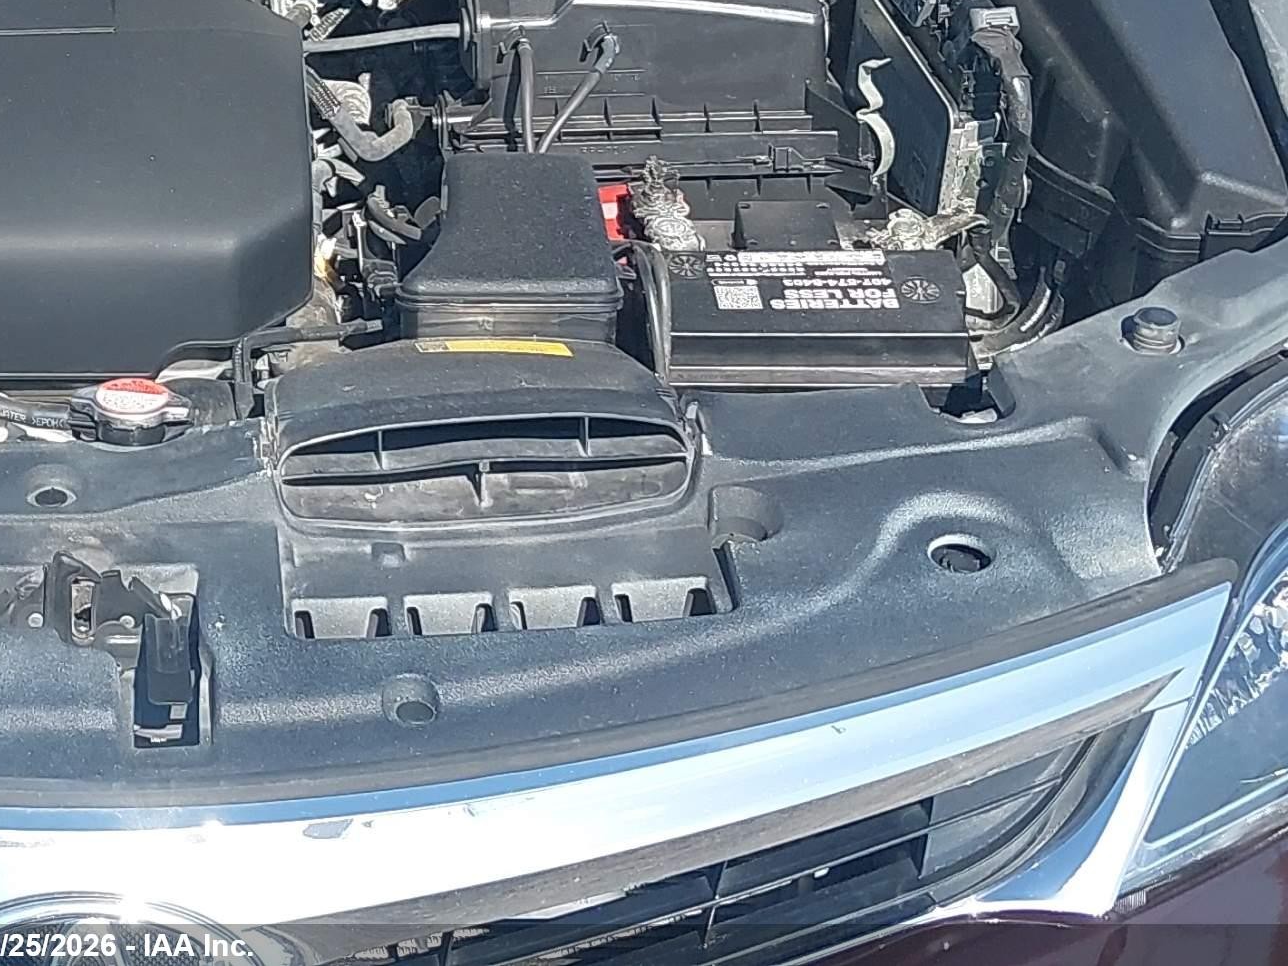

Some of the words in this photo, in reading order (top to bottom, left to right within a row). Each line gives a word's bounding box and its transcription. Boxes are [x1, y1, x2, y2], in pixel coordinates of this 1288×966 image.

[784, 288, 844, 299] LESS
[847, 288, 897, 299] FOR
[769, 298, 900, 309] BATTERIES
